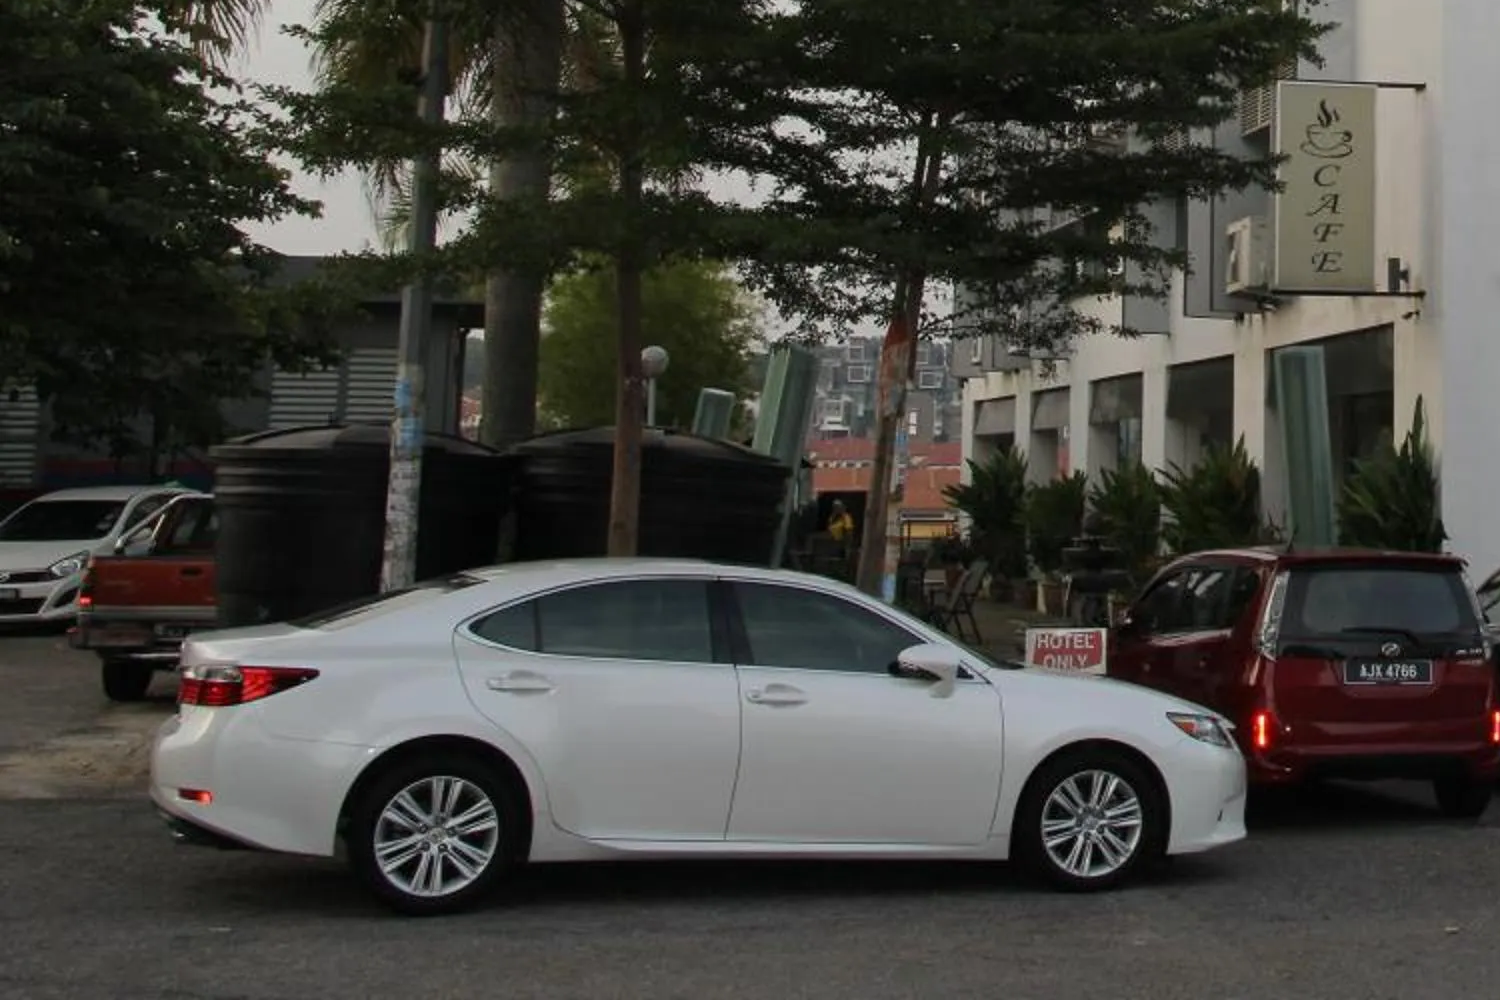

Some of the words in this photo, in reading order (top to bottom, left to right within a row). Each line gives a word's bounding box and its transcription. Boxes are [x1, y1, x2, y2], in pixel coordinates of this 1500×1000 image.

[1037, 632, 1095, 649] HOTEL
[1043, 653, 1088, 671] ONLY
[1359, 663, 1383, 677] AJX
